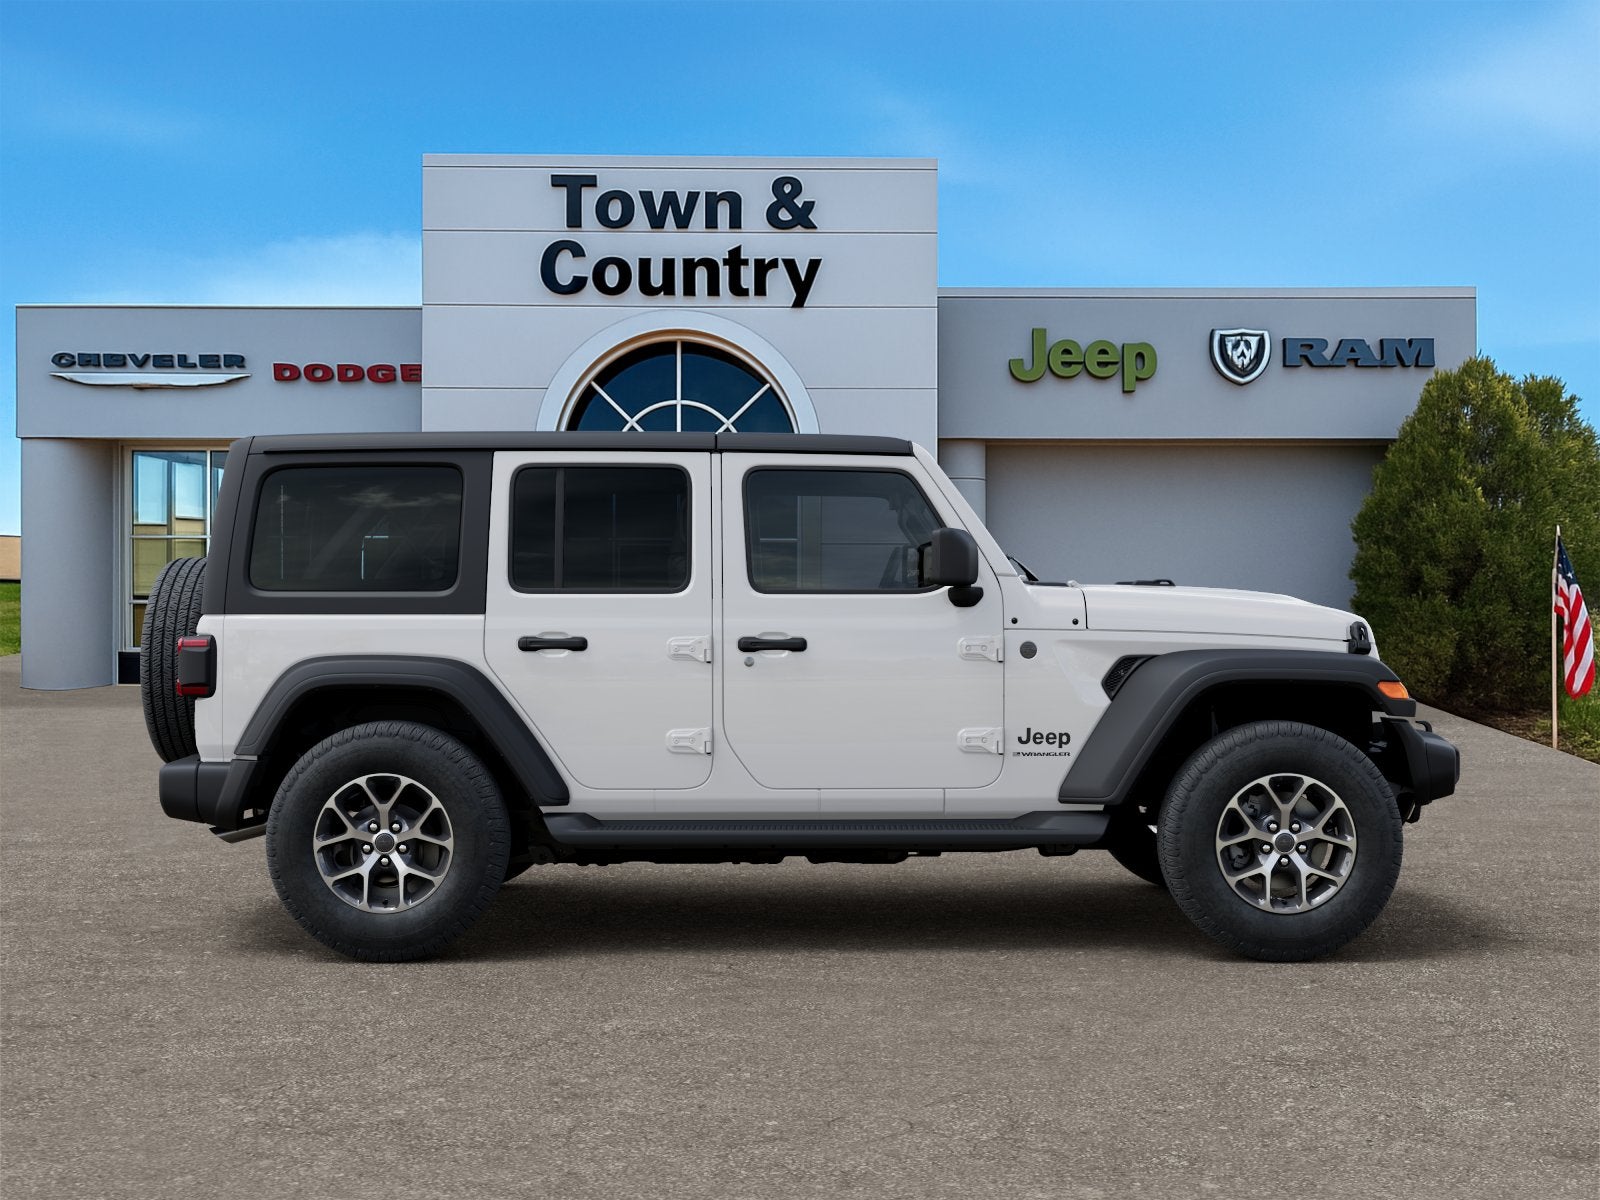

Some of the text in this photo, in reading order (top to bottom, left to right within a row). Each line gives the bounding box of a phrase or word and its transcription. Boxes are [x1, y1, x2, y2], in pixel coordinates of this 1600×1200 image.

[551, 174, 818, 230] Town &
[540, 239, 822, 308] Country
[273, 363, 422, 383] DODGE
[1009, 328, 1158, 393] Jeep
[1283, 338, 1435, 367] RAM
[1017, 727, 1071, 748] Jeep
